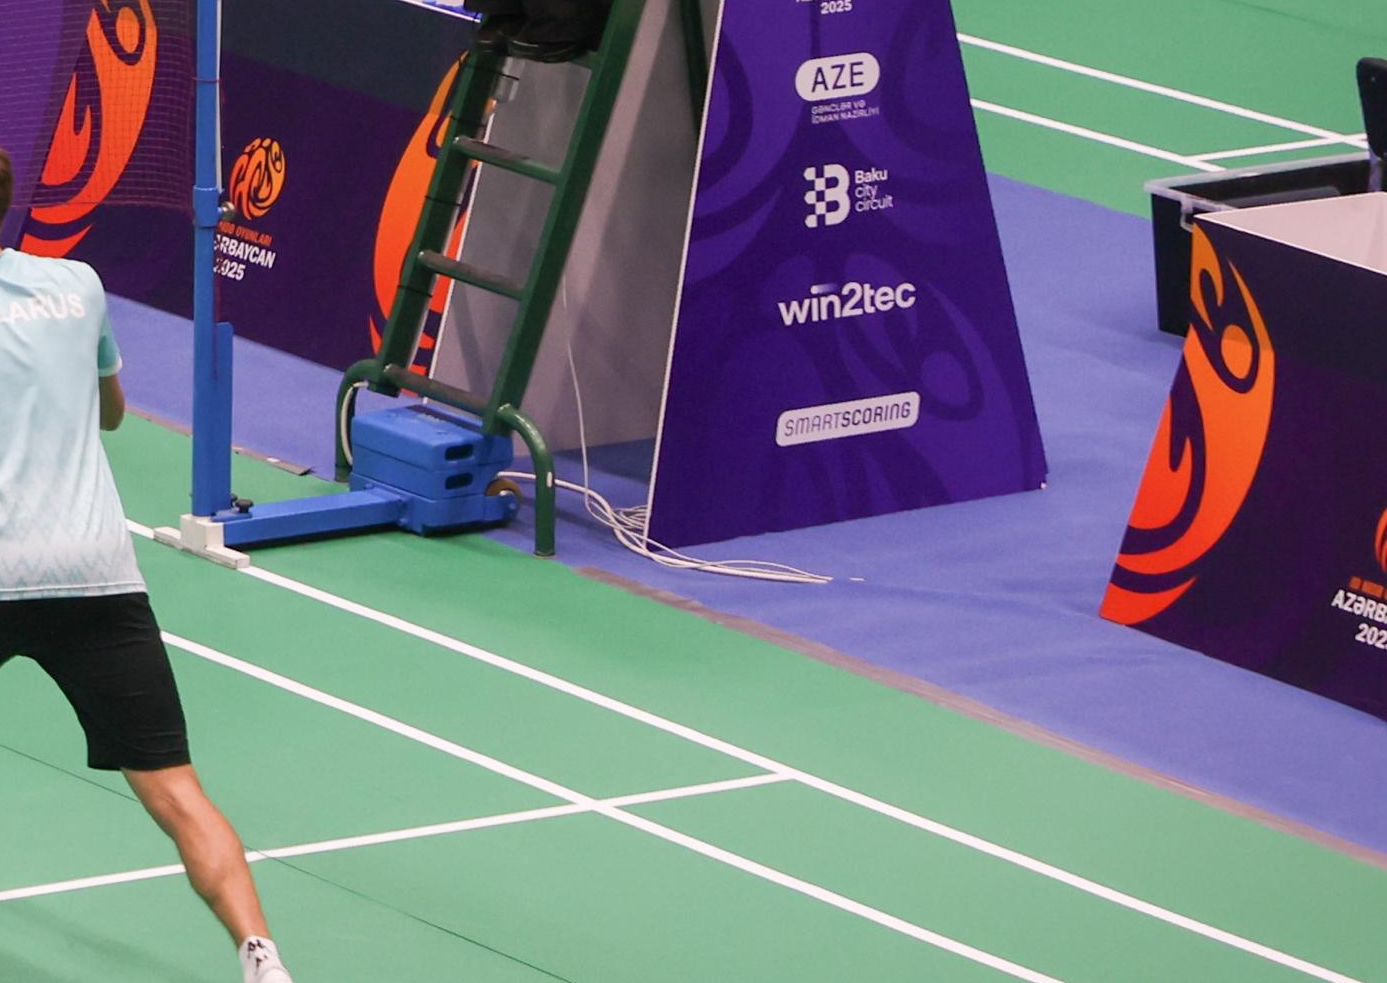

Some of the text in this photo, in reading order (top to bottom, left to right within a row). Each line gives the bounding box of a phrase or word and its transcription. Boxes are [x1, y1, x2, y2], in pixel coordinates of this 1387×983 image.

[811, 61, 864, 93] AZE
[855, 167, 888, 184] Baku
[855, 194, 894, 213] circuit
[778, 281, 916, 326] win2tec
[783, 401, 912, 438] SMARTSCORING
